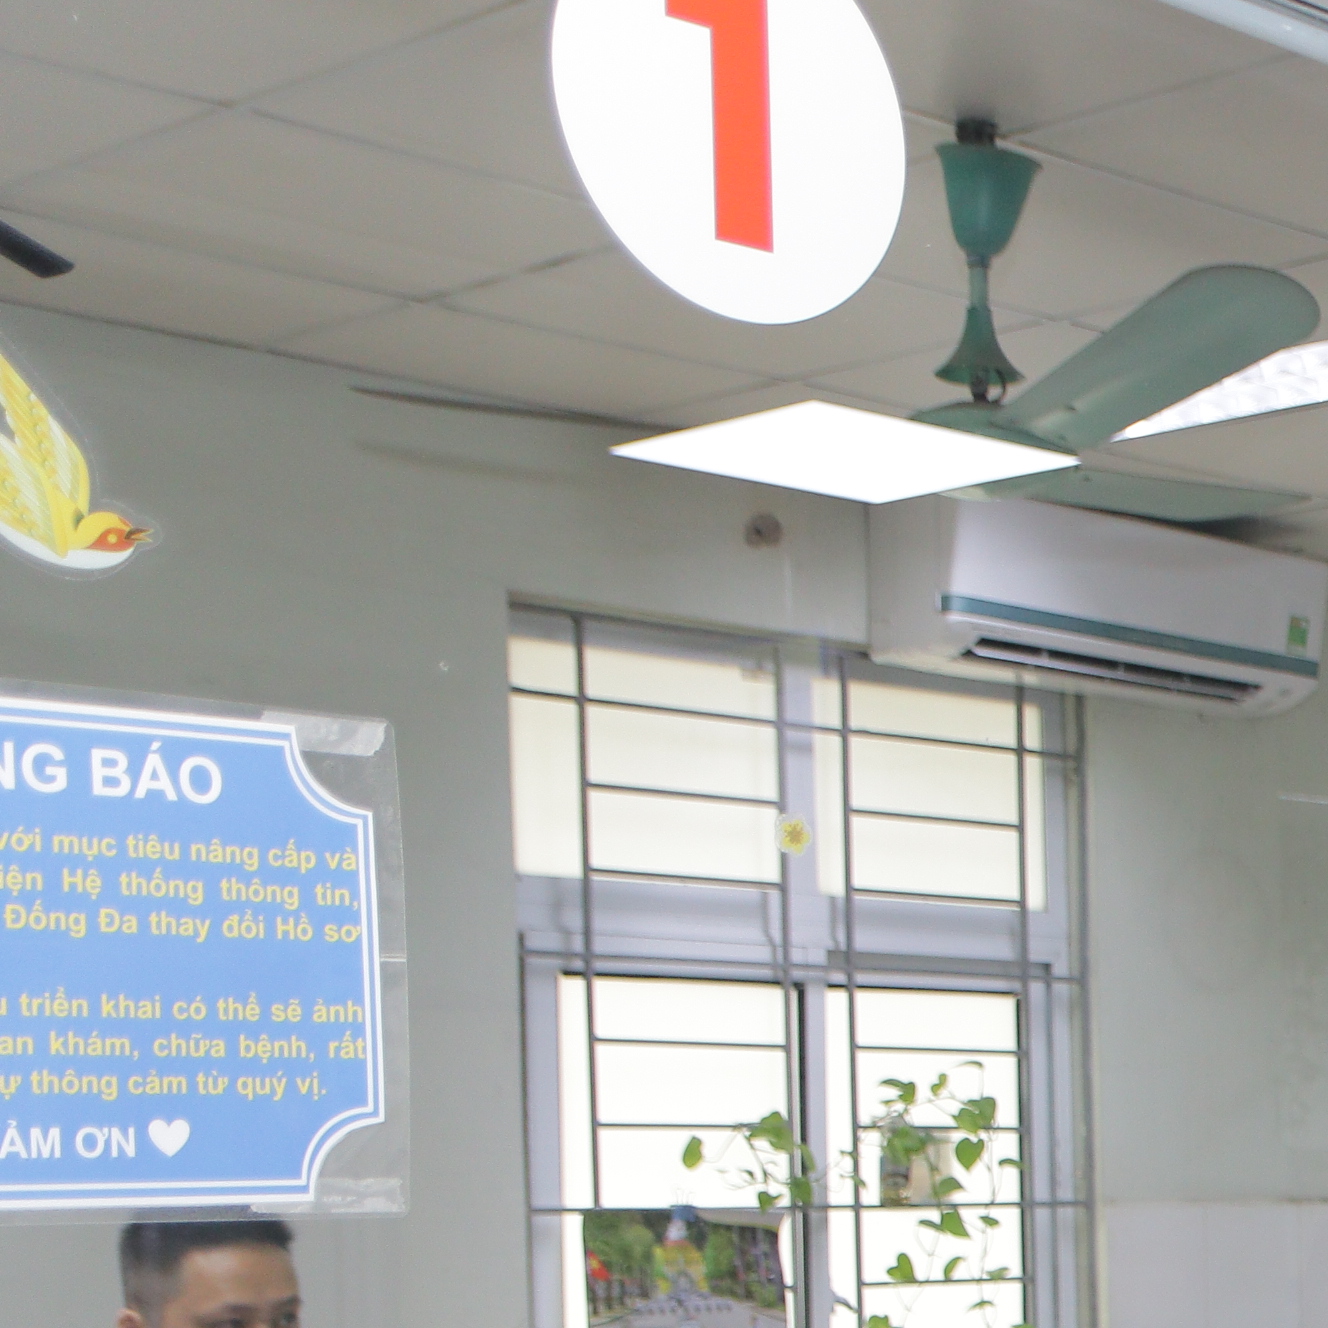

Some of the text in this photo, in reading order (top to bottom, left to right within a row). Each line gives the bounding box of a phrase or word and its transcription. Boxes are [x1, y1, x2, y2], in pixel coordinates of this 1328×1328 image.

[664, 0, 773, 253] 1
[91, 740, 222, 804] BÁO
[53, 834, 117, 861] mục
[127, 833, 180, 861] tiêu
[190, 838, 259, 871] nâng
[267, 838, 316, 873] cấp
[324, 846, 357, 871] và
[63, 867, 102, 899] Hệ
[119, 867, 204, 905] thống
[220, 876, 299, 910] thông
[315, 882, 359, 911] tin,
[4, 899, 362, 943] Đống Đa thay đổi Hồ sơ
[20, 986, 89, 1018] triển
[101, 993, 161, 1020] khai
[172, 995, 207, 1021] có
[217, 991, 261, 1021] thể
[271, 998, 302, 1022] sẽ
[312, 998, 363, 1023] ảnh
[50, 1030, 140, 1061] khám,
[153, 1033, 226, 1058] chữa
[239, 1033, 315, 1064] bệnh,
[328, 1030, 365, 1060] rất
[30, 1069, 118, 1101] thông
[128, 1069, 187, 1094] cảm
[196, 1069, 228, 1095] từ
[236, 1070, 287, 1101] quý
[295, 1071, 327, 1101] vị.
[75, 1127, 136, 1159] ƠN
